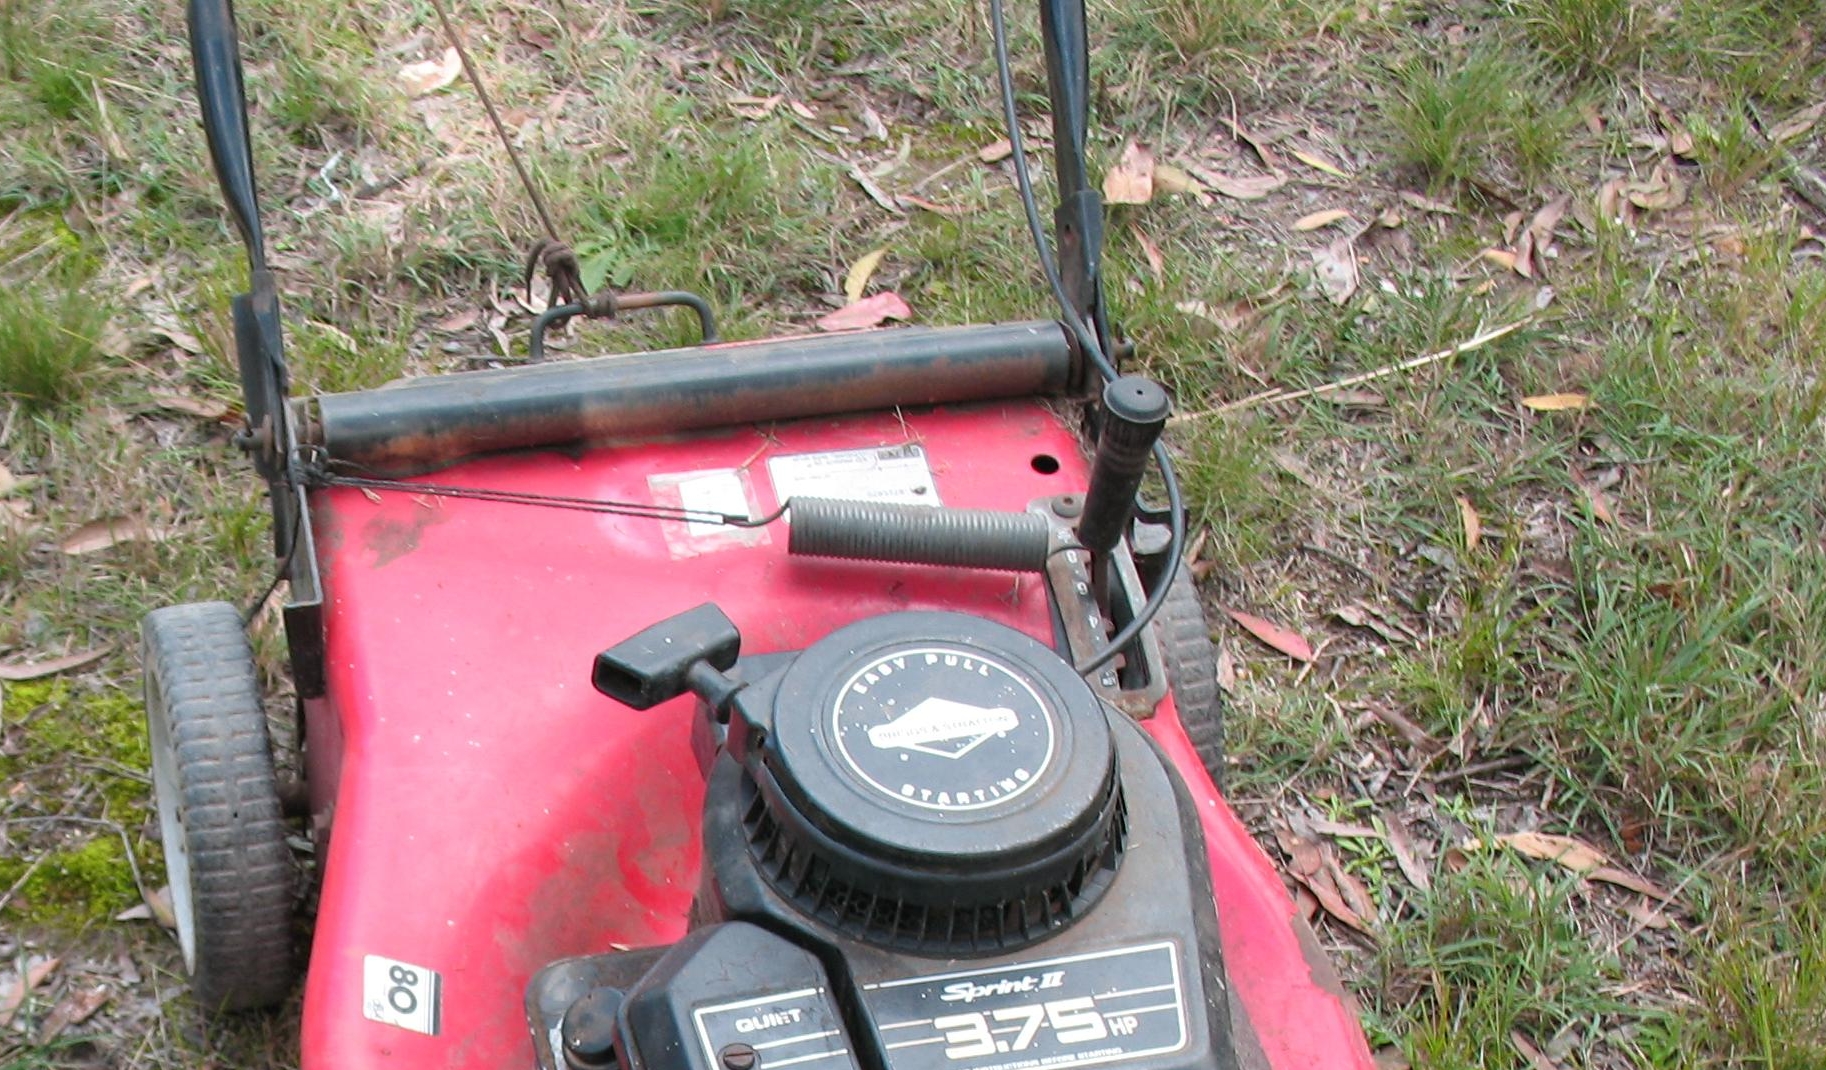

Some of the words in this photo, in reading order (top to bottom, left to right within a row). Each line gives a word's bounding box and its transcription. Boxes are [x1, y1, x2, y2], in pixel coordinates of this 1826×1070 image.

[852, 657, 906, 695] EASY
[924, 653, 989, 677] PULL
[901, 768, 1030, 806] STARTING
[387, 965, 419, 1015] 80
[940, 975, 1038, 1003] Sprint
[1040, 971, 1067, 990] II
[735, 1007, 802, 1033] QUIET
[934, 996, 1108, 1060] 3.75
[1107, 1015, 1139, 1037] HP
